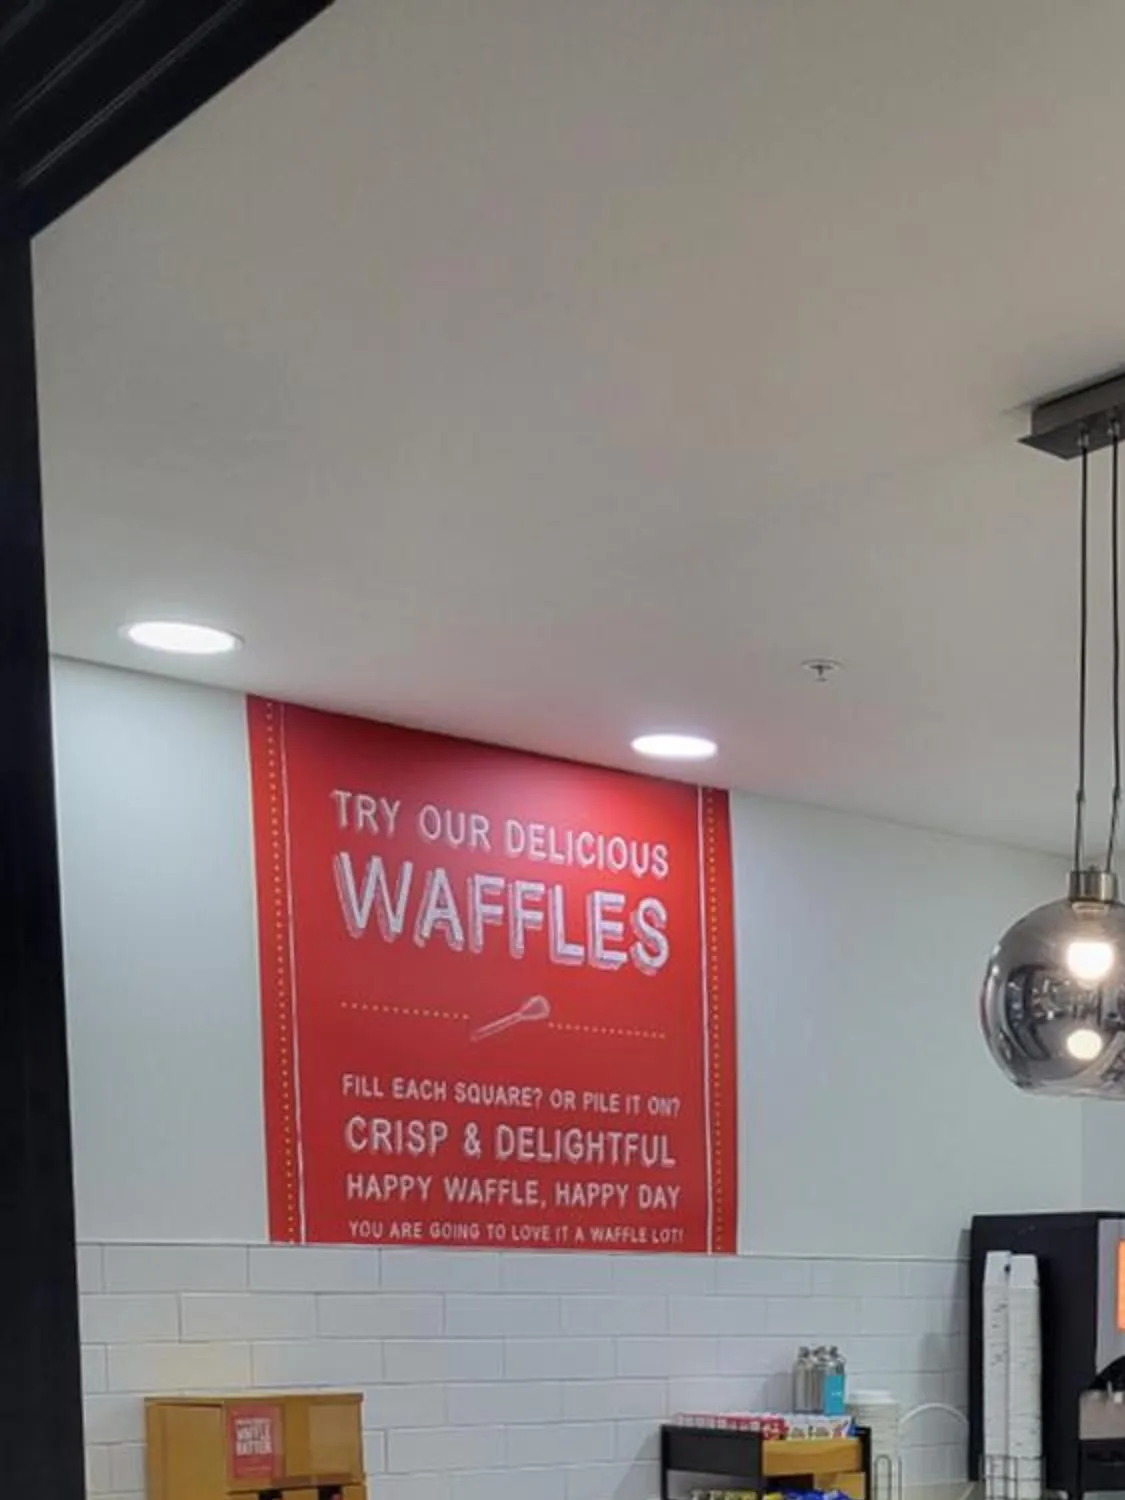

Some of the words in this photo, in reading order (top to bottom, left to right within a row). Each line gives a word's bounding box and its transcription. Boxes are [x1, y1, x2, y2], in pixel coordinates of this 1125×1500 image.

[331, 789, 401, 834] TRY
[418, 804, 491, 849] OUR
[505, 818, 669, 880] DELICIOUS
[333, 851, 670, 976] WAFFLES
[342, 1073, 385, 1097] FILL
[391, 1077, 447, 1102] EACH
[454, 1082, 543, 1109] SQUARE?
[549, 1089, 577, 1110] OR
[583, 1092, 620, 1115] PILE
[625, 1095, 641, 1116] IT
[647, 1096, 681, 1118] ON?
[344, 1115, 449, 1155] CRISP
[463, 1122, 482, 1158] &
[495, 1123, 677, 1168] DELIGHTFUL
[346, 1173, 433, 1202] HAPPY
[443, 1177, 547, 1209] WAFFLE,
[555, 1181, 630, 1209] HAPPY
[638, 1184, 681, 1209] DAY
[348, 1220, 384, 1239] YOU
[389, 1221, 423, 1239] ARE
[429, 1222, 480, 1240] GOING
[485, 1223, 507, 1240] TO
[511, 1224, 551, 1242] LOVE
[555, 1225, 570, 1242] IT
[575, 1226, 586, 1243] A
[590, 1226, 647, 1244] WAFFLE
[651, 1227, 685, 1245] LOT!
